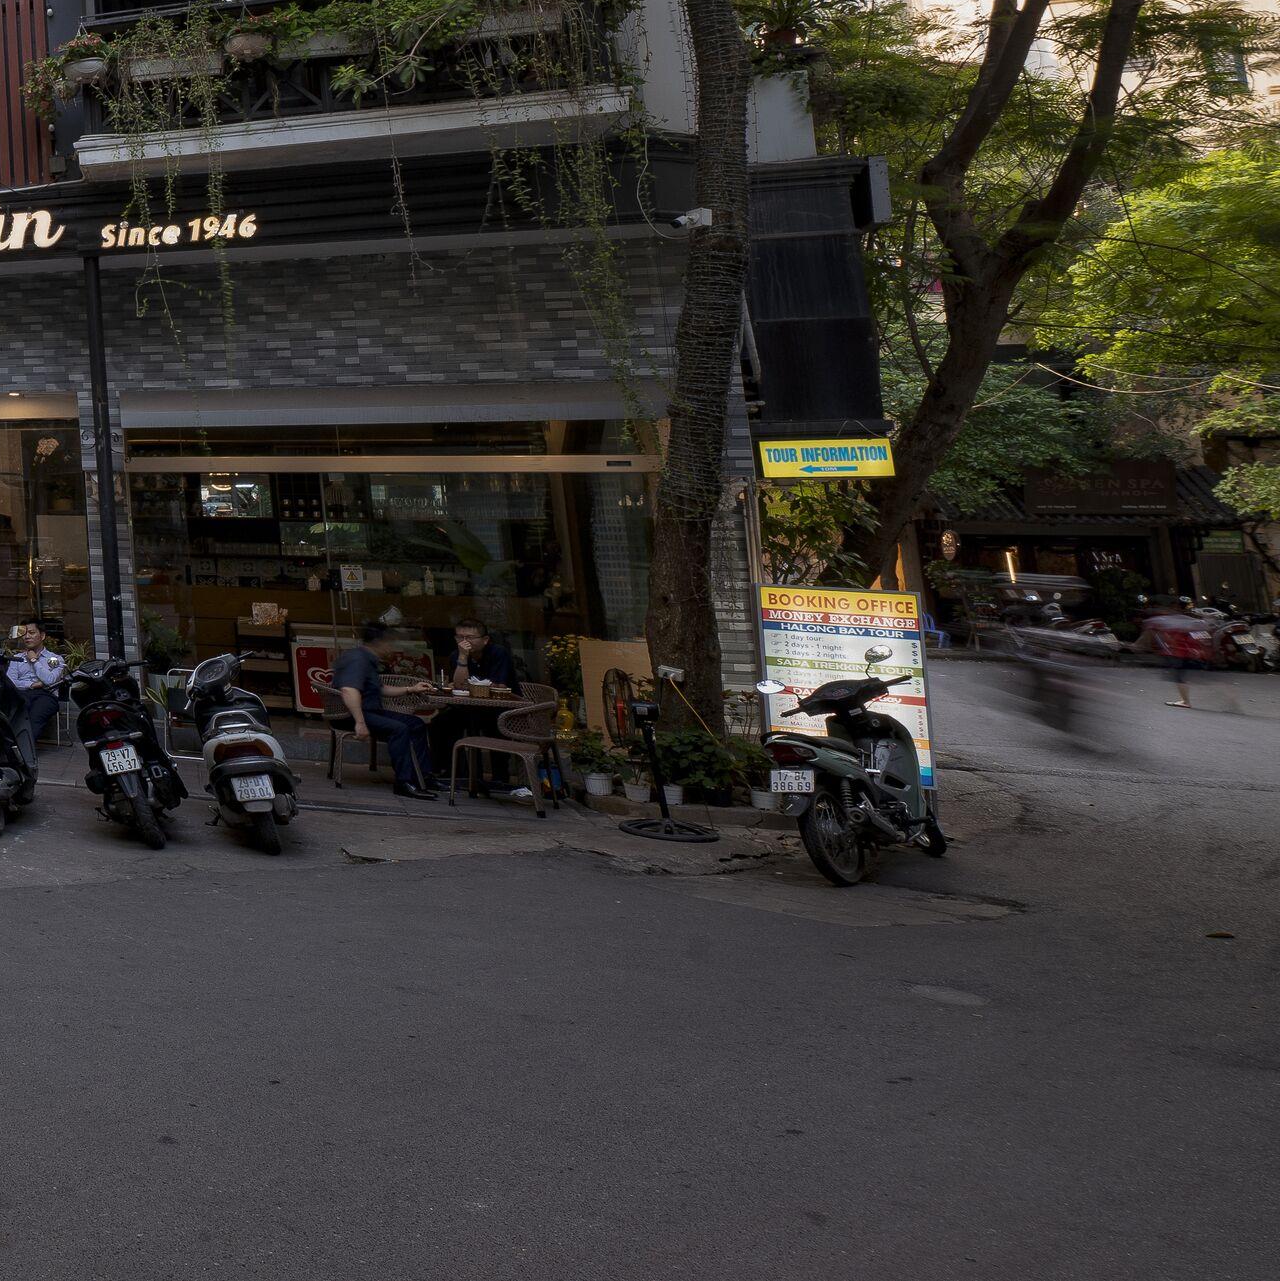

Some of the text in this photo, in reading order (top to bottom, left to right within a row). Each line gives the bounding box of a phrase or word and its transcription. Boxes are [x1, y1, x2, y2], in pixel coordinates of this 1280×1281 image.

[101, 221, 181, 249] Since
[188, 213, 258, 243] 1946
[765, 446, 888, 463] TOUR INFORMATION
[768, 593, 914, 614] BOOKING OFFICE
[768, 609, 916, 629] MONEY EXCHANGE
[780, 622, 904, 639] HALONG BAY TOUR
[790, 633, 804, 642] day
[790, 641, 809, 650] days
[791, 649, 809, 658] days
[776, 658, 915, 676] SAPA TREKKING TOUR
[106, 748, 132, 762] 29-V7
[107, 759, 138, 774] 456.37
[772, 782, 812, 792] 386.69
